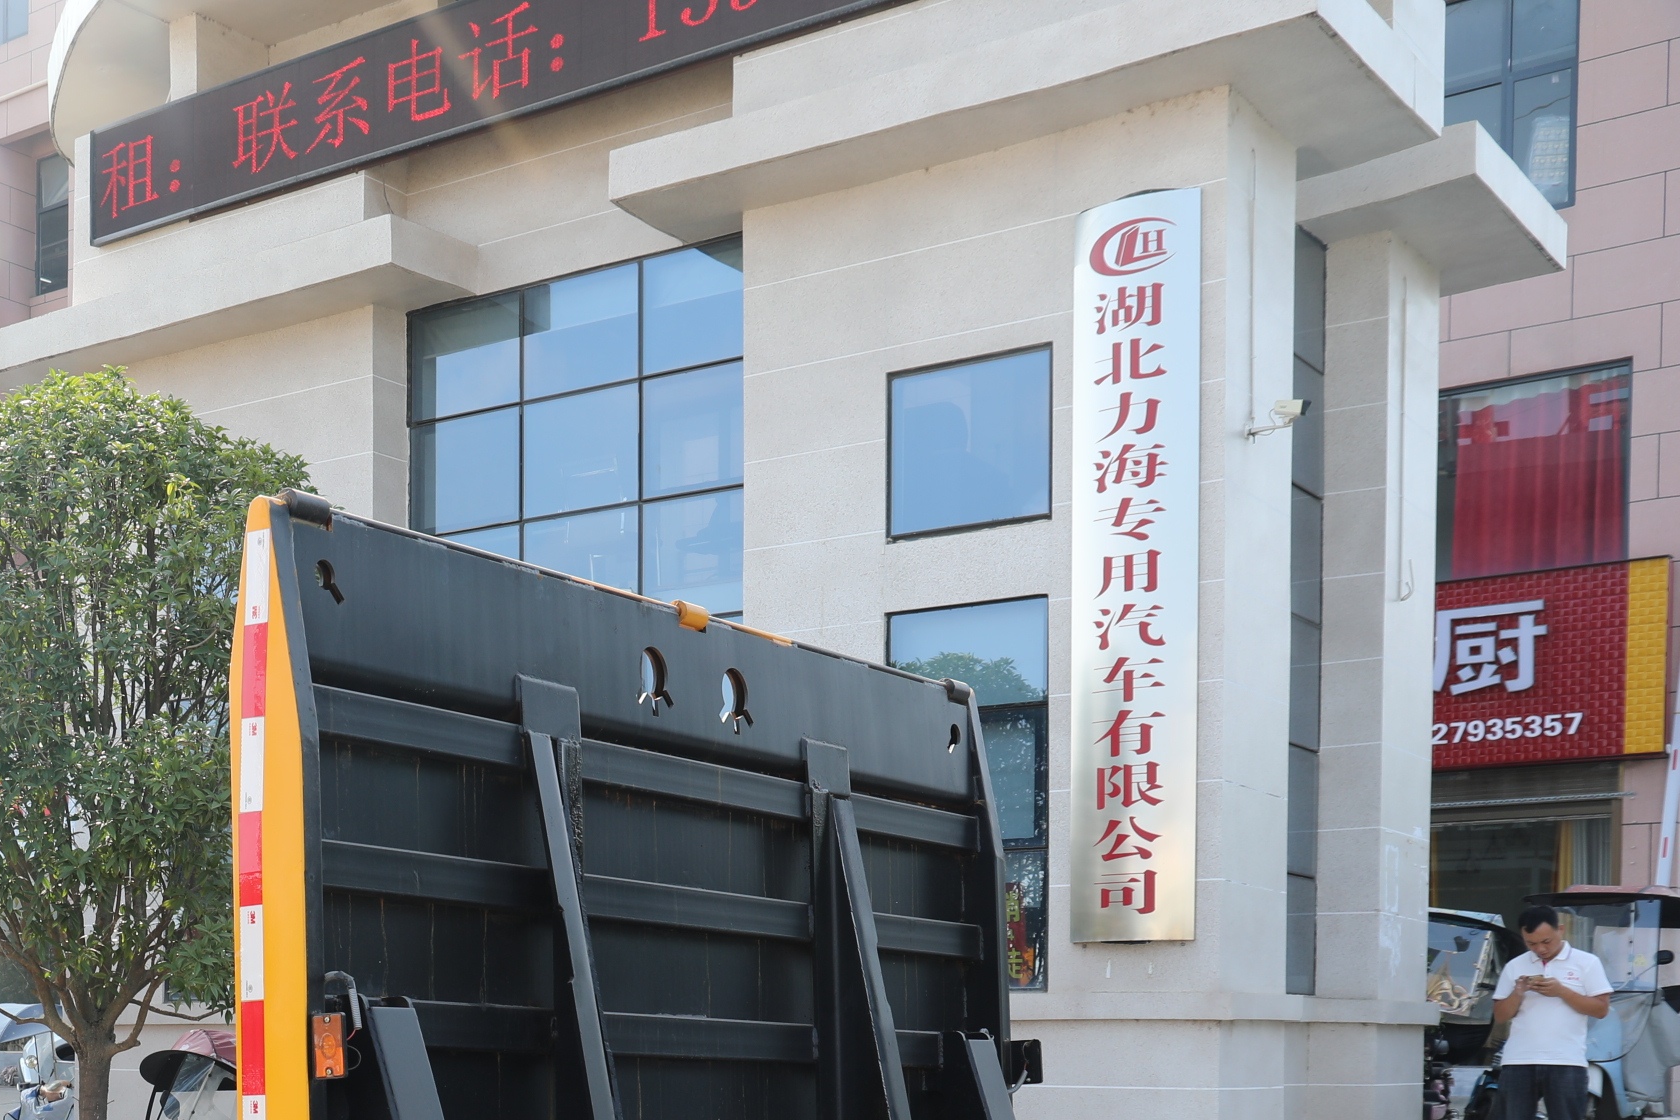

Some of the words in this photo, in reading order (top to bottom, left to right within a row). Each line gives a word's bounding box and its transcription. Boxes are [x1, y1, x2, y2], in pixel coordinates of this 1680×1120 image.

[1092, 281, 1169, 916] 湖北力海专用汽车有限公司
[1432, 598, 1549, 696] 厨
[1431, 712, 1584, 746] 27935357
